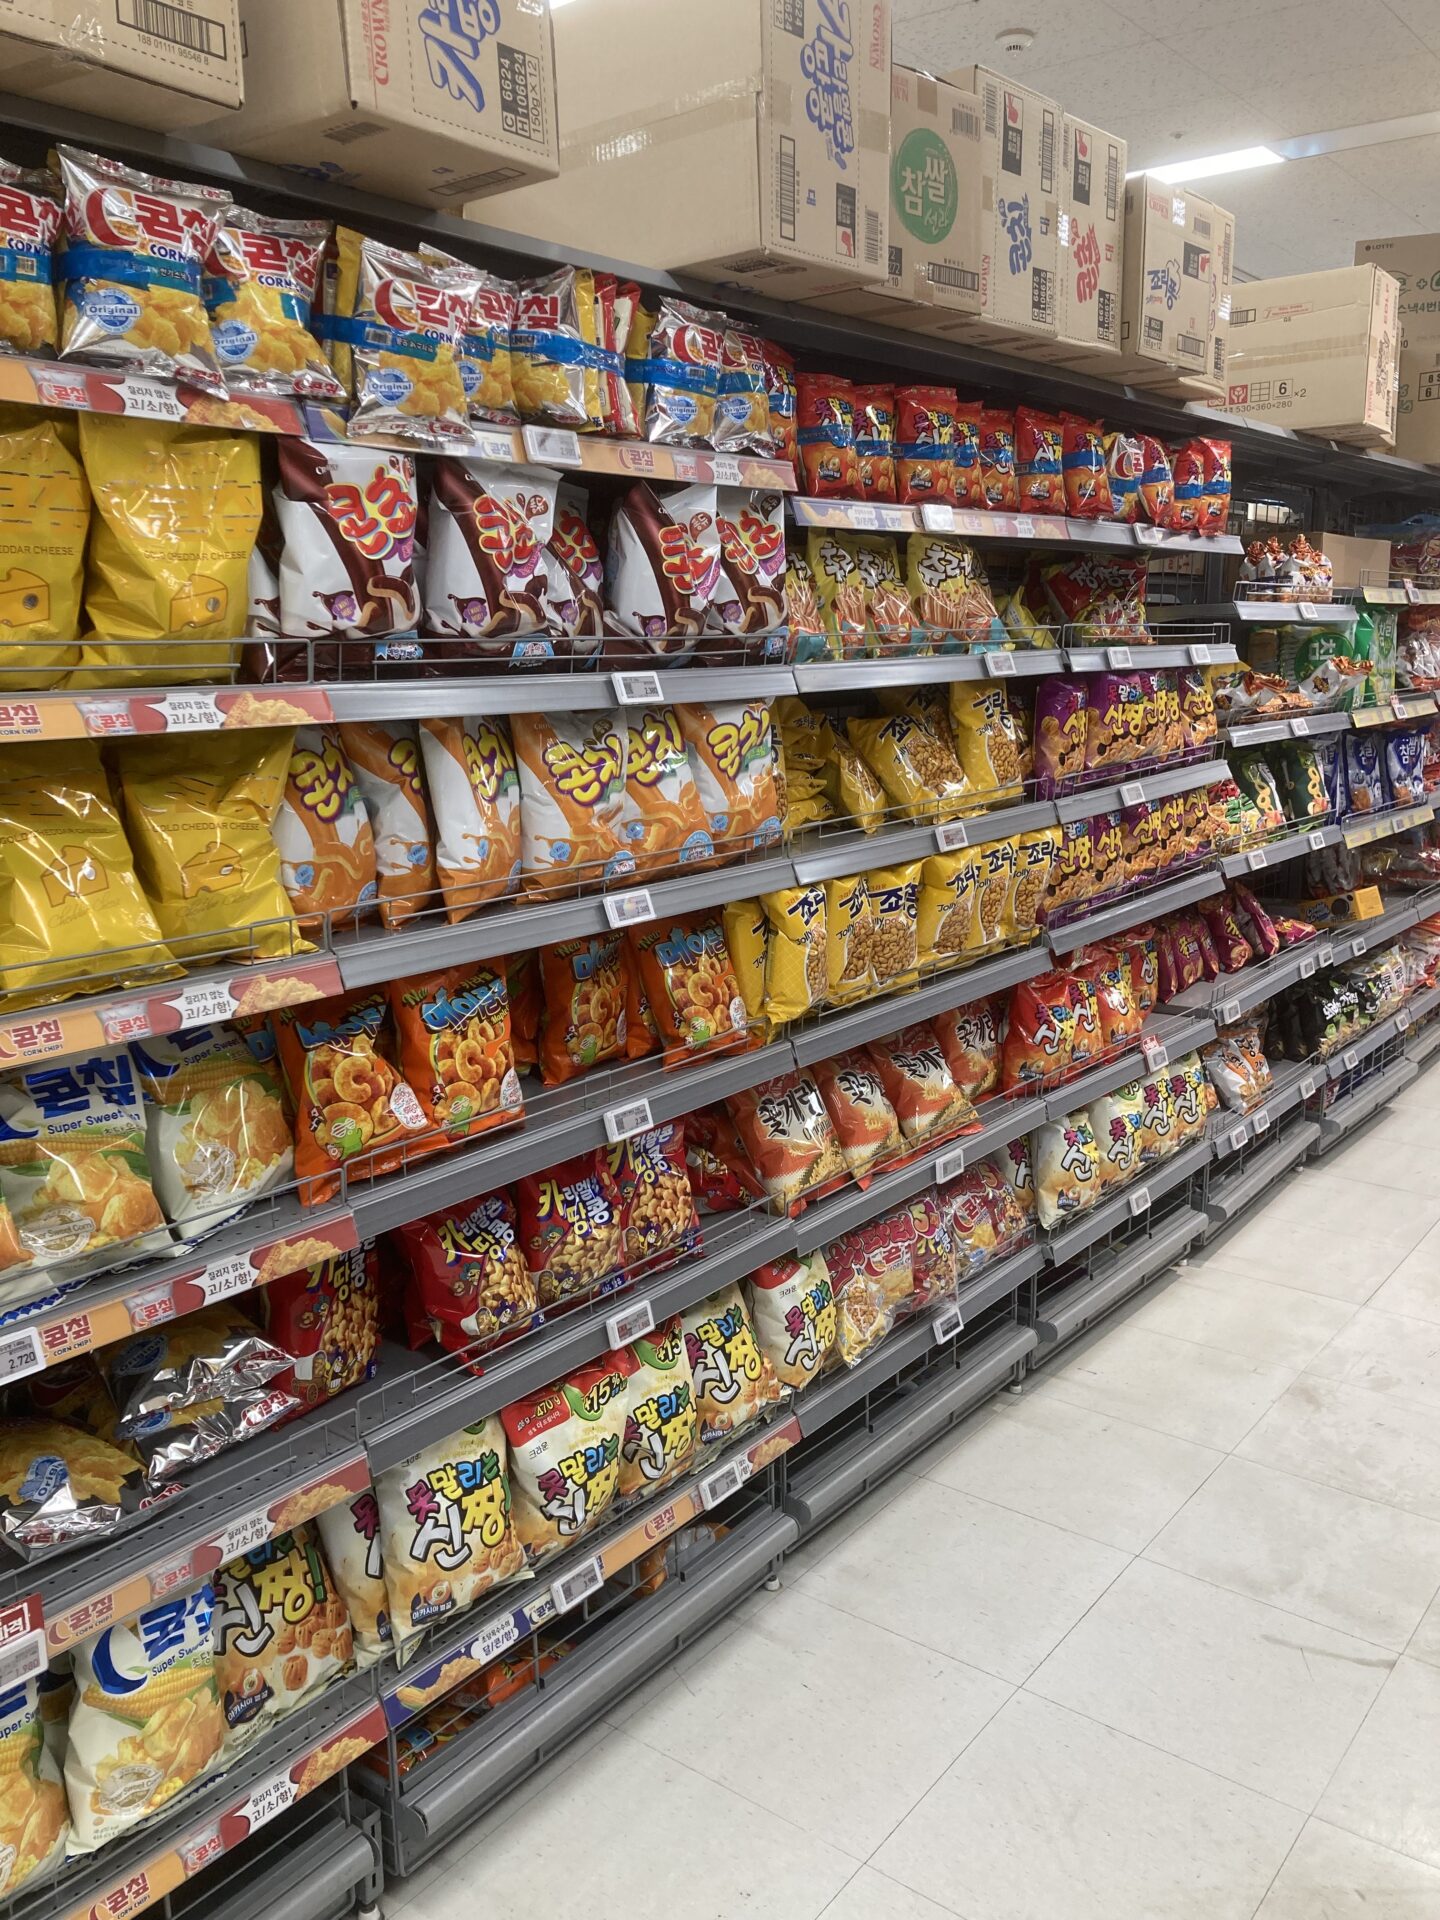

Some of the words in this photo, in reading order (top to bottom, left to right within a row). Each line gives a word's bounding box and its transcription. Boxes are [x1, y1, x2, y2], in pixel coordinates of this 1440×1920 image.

[870, 2, 885, 69] CROWN
[501, 58, 514, 101] 6624
[514, 52, 529, 116] 106624
[518, 118, 529, 135] H
[900, 155, 949, 218] 참쌀
[149, 243, 188, 264] CORN
[241, 231, 319, 290] 콘칩
[258, 274, 292, 289] CORN
[1146, 267, 1178, 311] 죠리퐁
[89, 306, 138, 316] Original
[213, 333, 256, 346] Original
[424, 329, 454, 346] CORN
[54, 384, 87, 402] 콘칩
[127, 384, 153, 399] 질리지
[154, 387, 171, 399] 않는
[371, 382, 412, 391] Original
[1278, 381, 1288, 395] 6
[668, 405, 697, 414] Original
[629, 449, 654, 467] 콘칩
[34, 545, 75, 556] CHEESE
[211, 550, 247, 561] CHEESE
[168, 701, 192, 711] 질리지
[193, 700, 211, 710] 않는
[1103, 700, 1144, 736] 신짱
[100, 711, 133, 730] 콘칩
[706, 708, 770, 781] 콘치
[543, 735, 622, 807] 콘치
[181, 822, 228, 833] CHEDDAR
[229, 822, 260, 832] CHEESE
[1059, 833, 1093, 874] 신짱
[786, 886, 828, 927] 죠리
[185, 993, 208, 1007] 질리지
[208, 989, 225, 1001] 않는
[185, 1001, 232, 1021] 고/소/함!
[11, 1017, 63, 1048] 콘칩
[117, 1014, 148, 1033] 콘칩
[23, 1047, 43, 1058] CORN
[183, 1051, 211, 1067] Super
[213, 1039, 241, 1053] Sweet
[24, 1054, 139, 1120] 콘칩
[836, 1069, 884, 1106] 꽃게
[757, 1077, 824, 1139] 꽃게랑
[47, 1117, 84, 1135] Super
[85, 1109, 124, 1127] Sweet
[72, 1220, 93, 1233] Corn
[472, 1218, 515, 1261] 땅콩
[207, 1265, 231, 1282] 질리지
[231, 1260, 247, 1274] 않는
[207, 1270, 253, 1298] 고/소/함!
[778, 1284, 798, 1298] 크라운
[144, 1297, 174, 1319] 콘칩
[784, 1279, 833, 1339] 못말리는
[43, 1314, 93, 1350] 콘칩
[783, 1310, 837, 1371] 신짱
[53, 1346, 72, 1358] CORN
[692, 1323, 763, 1404] 신짱
[528, 1440, 550, 1460] 크라운
[537, 1433, 619, 1501] 못말리는
[404, 1448, 502, 1525] 못말리는
[540, 1461, 620, 1537] 신짱
[225, 1523, 249, 1541] 질리지
[248, 1516, 265, 1534] 않는
[350, 1492, 380, 1541] 못
[652, 1505, 675, 1533] 콘칩
[163, 1564, 192, 1589] 콘칩
[68, 1593, 115, 1631] 콘칩
[411, 1605, 438, 1622] 아카시아
[75, 1625, 94, 1638] CORN
[151, 1652, 177, 1678] Super
[226, 1696, 256, 1722] 아카시아
[251, 1789, 273, 1808] 질리지
[272, 1779, 288, 1797] 않는
[193, 1835, 222, 1862] 콘칩
[106, 1872, 149, 1914] 콘칩
[117, 1902, 135, 1920] CORN
